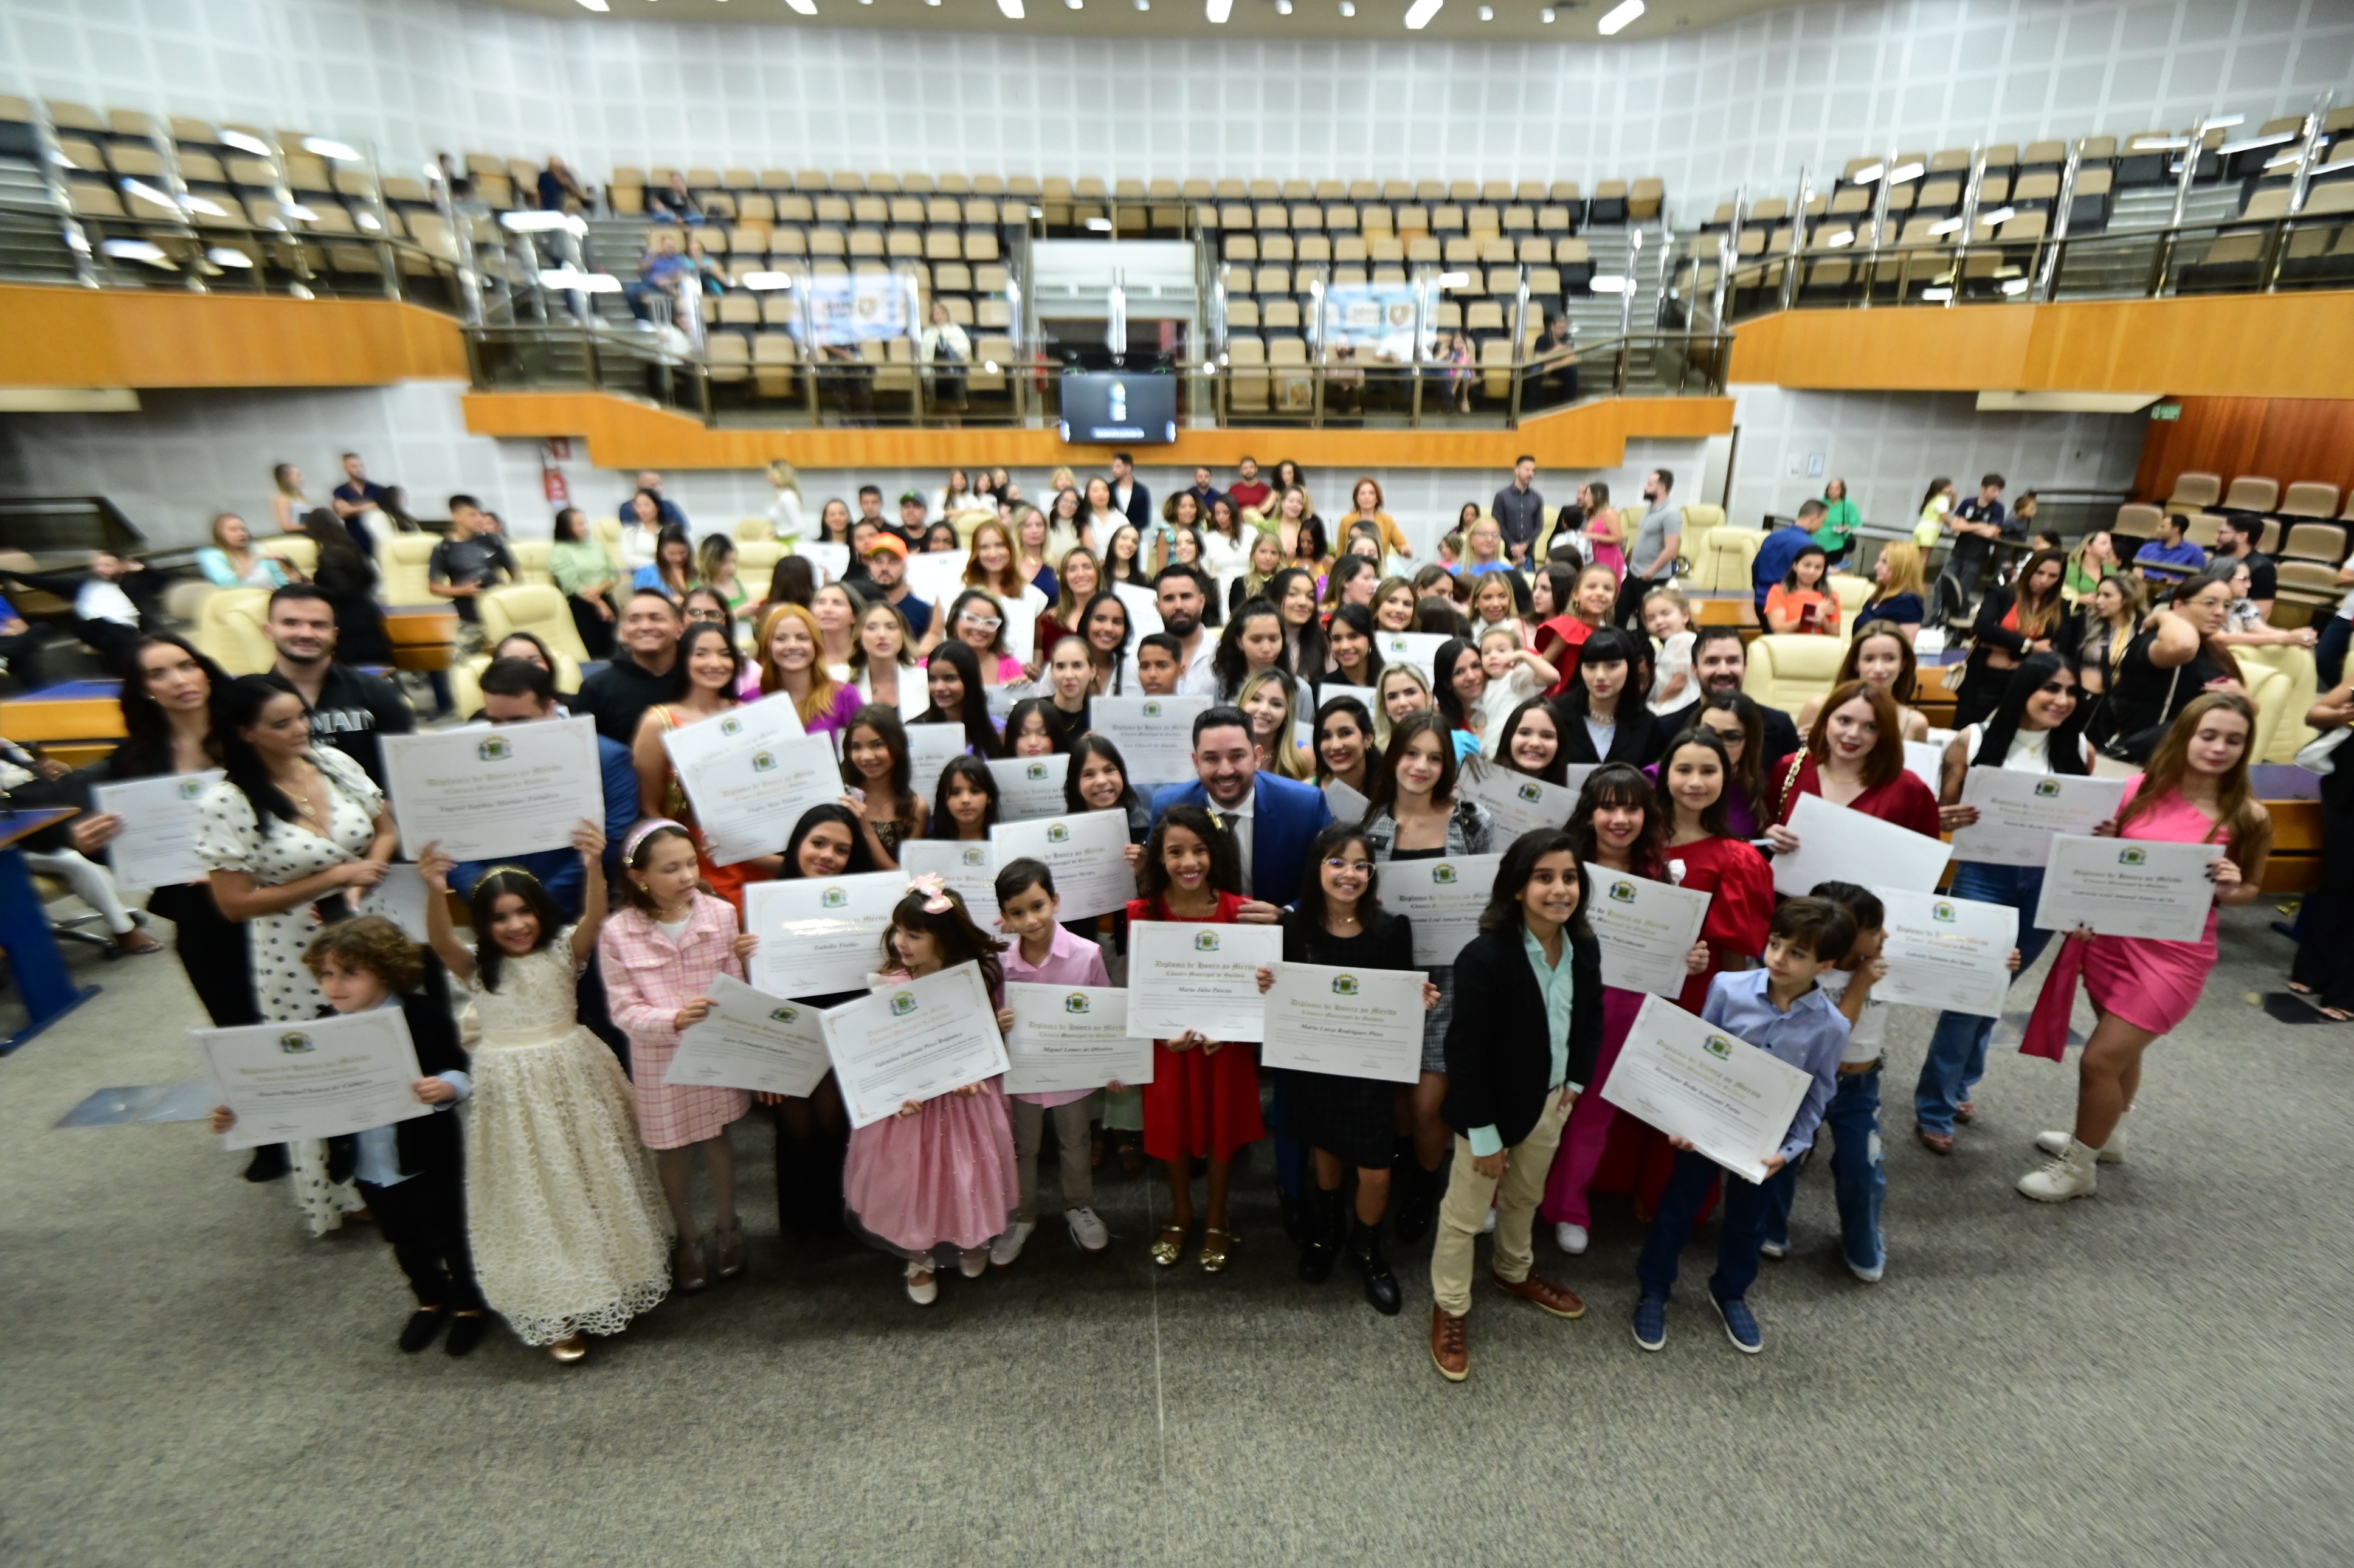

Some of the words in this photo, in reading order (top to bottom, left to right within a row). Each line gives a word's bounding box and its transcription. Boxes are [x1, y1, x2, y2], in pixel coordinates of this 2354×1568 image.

[1155, 960, 1186, 969] Diploma
[1196, 961, 1220, 970] Honra
[1231, 962, 1257, 971] Mérito
[1290, 998, 1322, 1009] Diploma
[1334, 1004, 1359, 1013] Honra
[1029, 1021, 1058, 1031] Diploma
[1068, 1023, 1092, 1031] Honra
